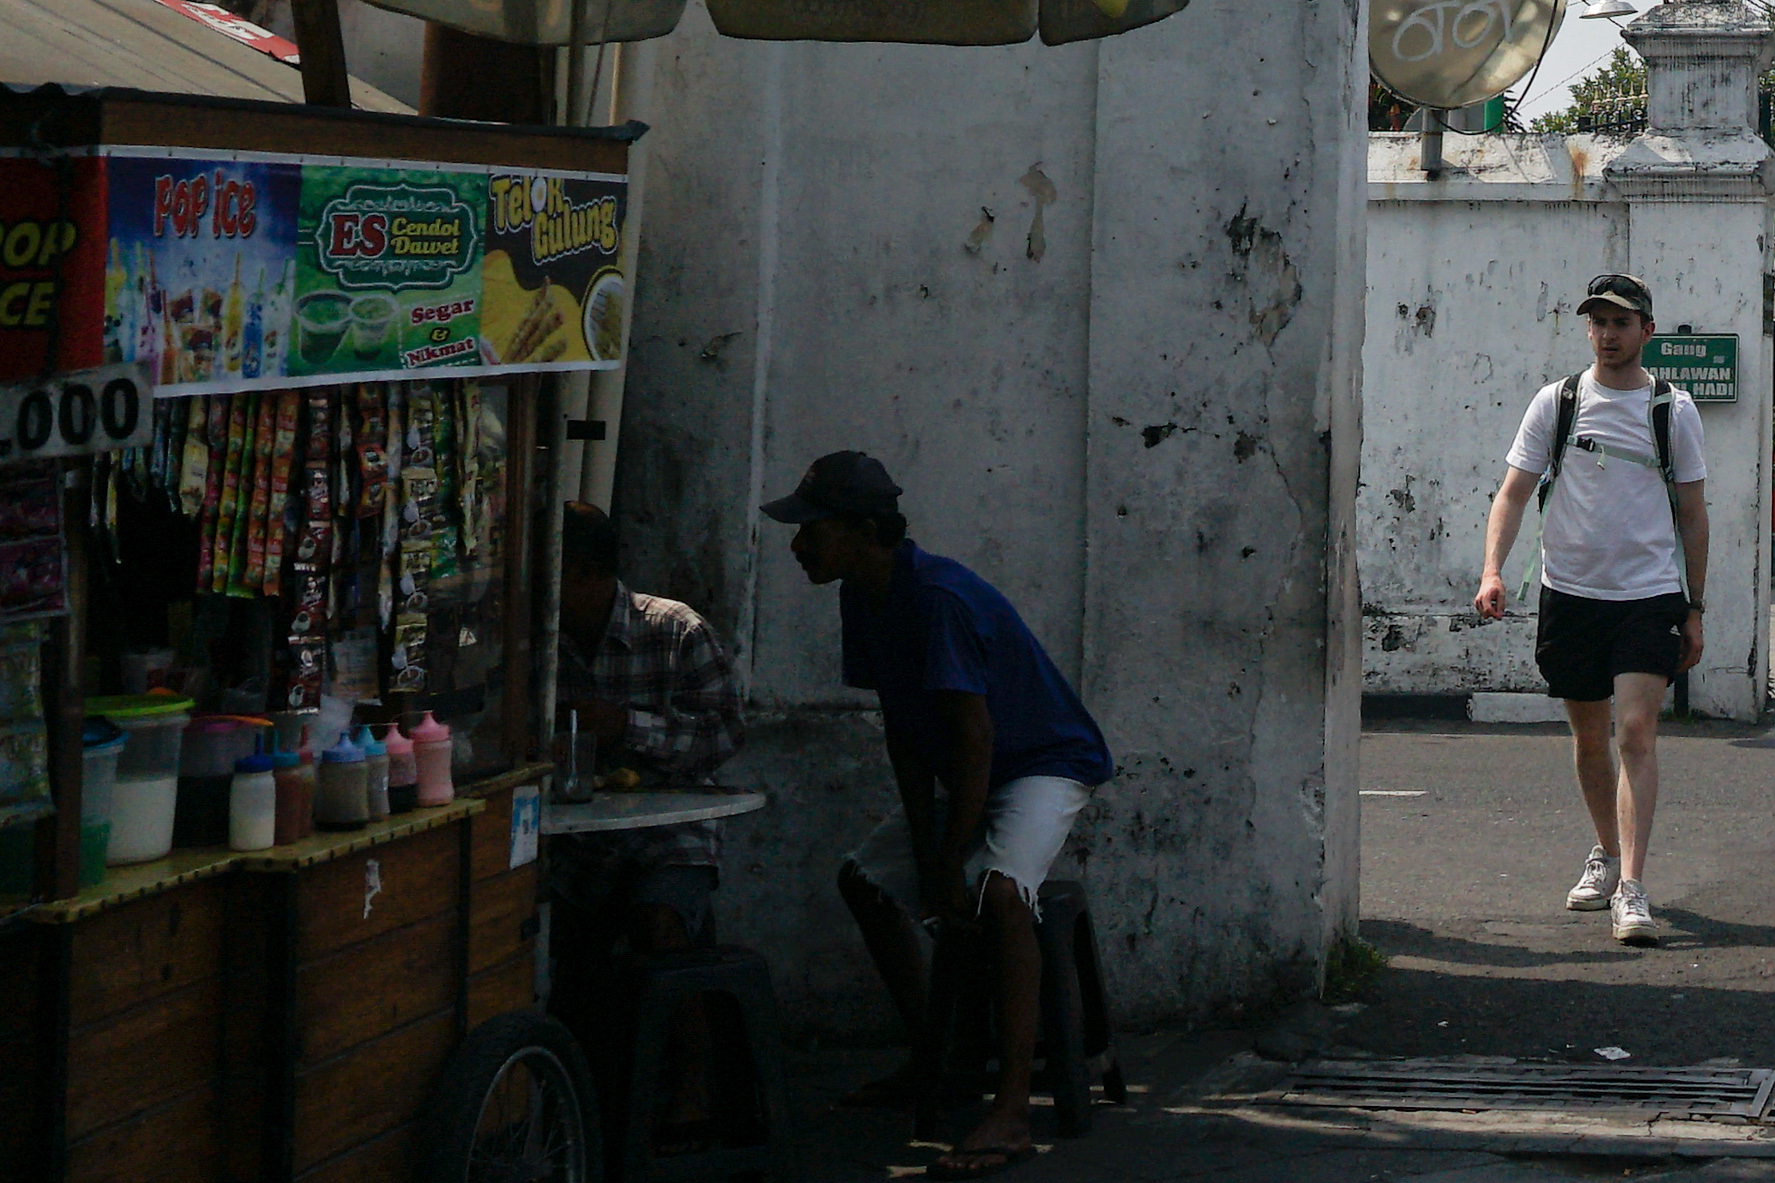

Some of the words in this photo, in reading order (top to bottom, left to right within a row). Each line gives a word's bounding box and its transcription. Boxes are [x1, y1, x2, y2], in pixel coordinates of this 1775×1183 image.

[154, 174, 208, 237] POP
[329, 213, 388, 258] ES
[391, 217, 460, 235] Cendol
[533, 200, 616, 261] Gulung
[0, 222, 77, 266] OP
[391, 236, 459, 255] Dawet
[411, 298, 475, 324] Segar
[1648, 367, 1731, 380] AHLAWAN
[1693, 383, 1734, 396] HADI
